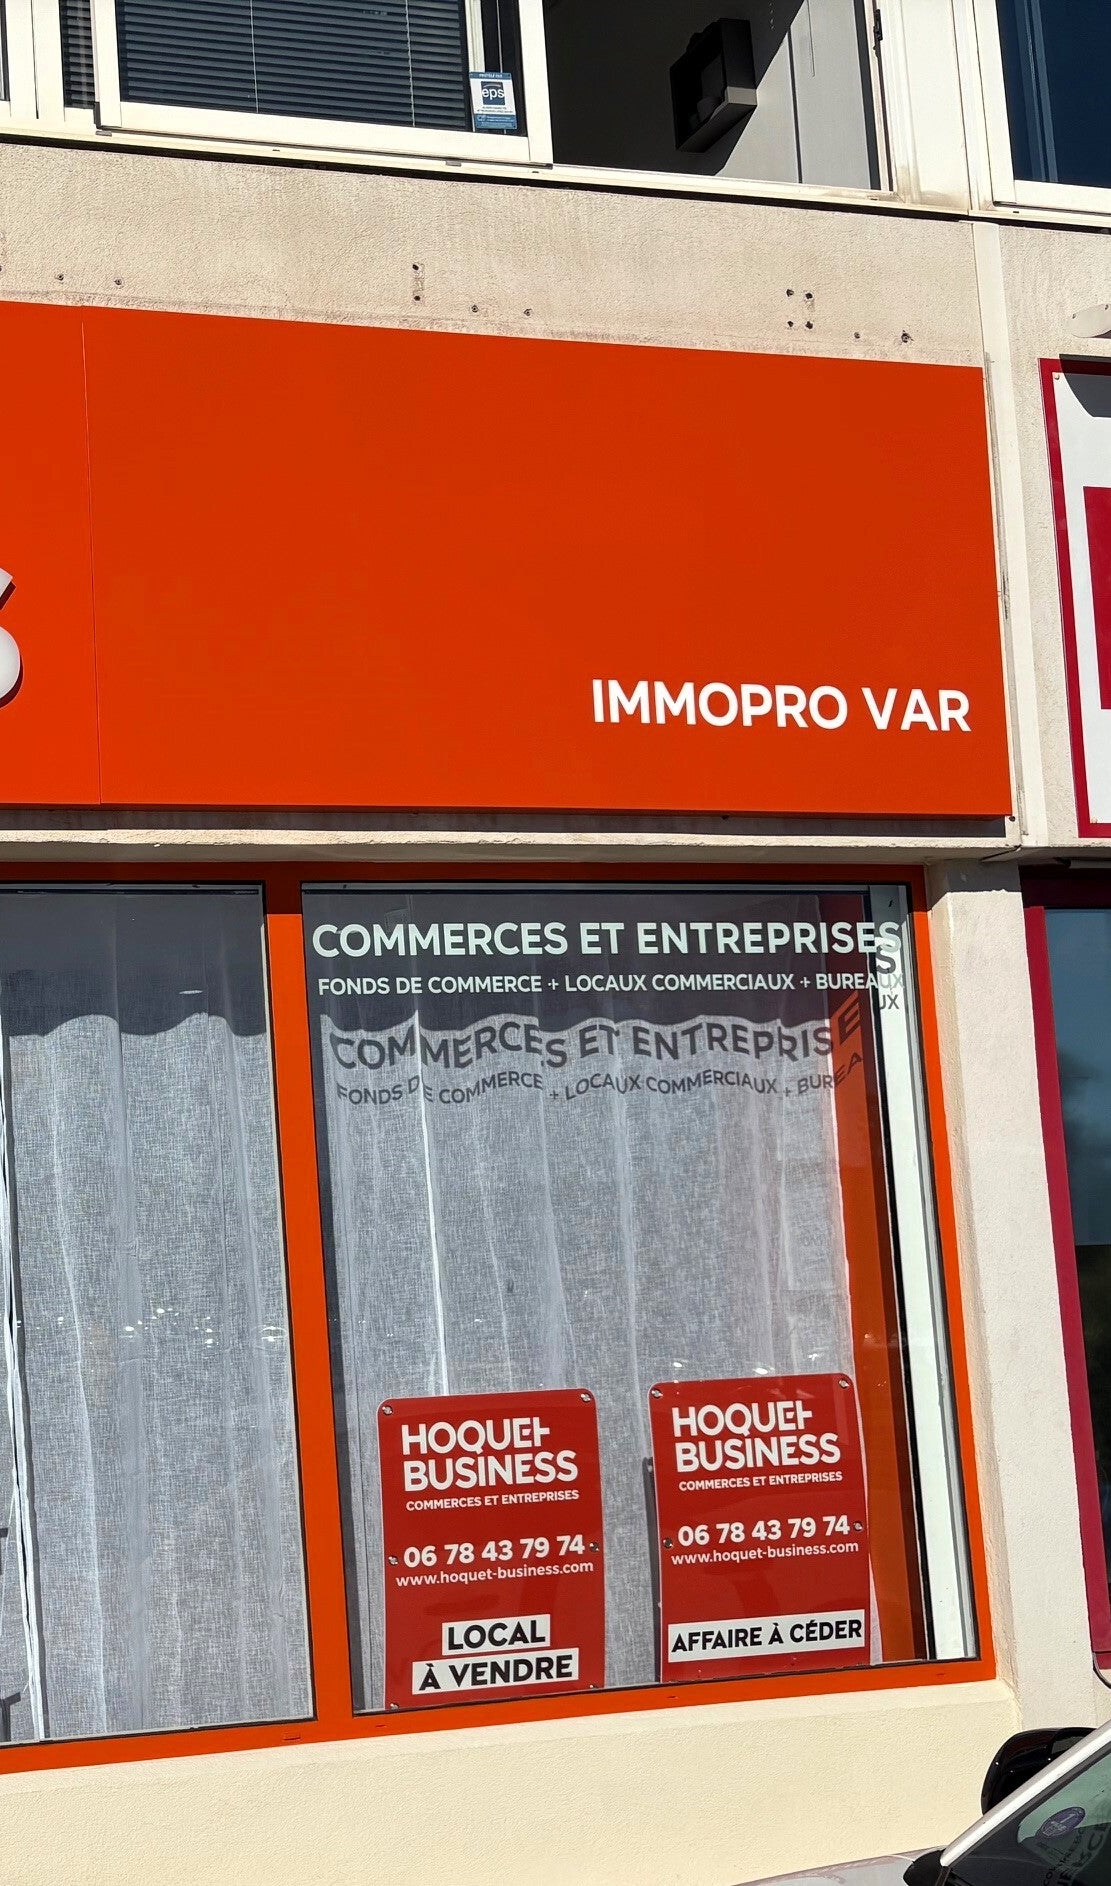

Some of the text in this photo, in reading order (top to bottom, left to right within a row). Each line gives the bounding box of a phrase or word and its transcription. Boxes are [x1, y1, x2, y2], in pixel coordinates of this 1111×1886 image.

[482, 88, 505, 100] eps
[592, 679, 971, 732] IMMOPRO VAR
[312, 922, 902, 957] COMMERCES ET ENTREPRISES
[318, 977, 390, 996] FONDS
[396, 976, 423, 994] DE
[427, 975, 542, 994] COMMERCE
[565, 974, 647, 992] LOCAUX
[652, 973, 795, 991] COMMERCIAUX
[816, 972, 904, 990] BUREAUX
[675, 1433, 841, 1473] BUSINESS
[403, 1450, 579, 1492] BUSINESS
[679, 1471, 843, 1491] COMMERCES ET ENTREPRISES
[406, 1489, 580, 1511] COMMERCES ET ENTREPRISES
[678, 1515, 850, 1546] 06 78 43 79 74
[403, 1534, 585, 1568] 06 78 43 79 74
[671, 1541, 859, 1565] www.hoquet-business.com
[396, 1561, 594, 1587] www.hoquet-business.com
[447, 1619, 546, 1651] LOCAL
[671, 1619, 862, 1653] AFFAIRE À CÉDER
[418, 1654, 573, 1691] À VENDRE
